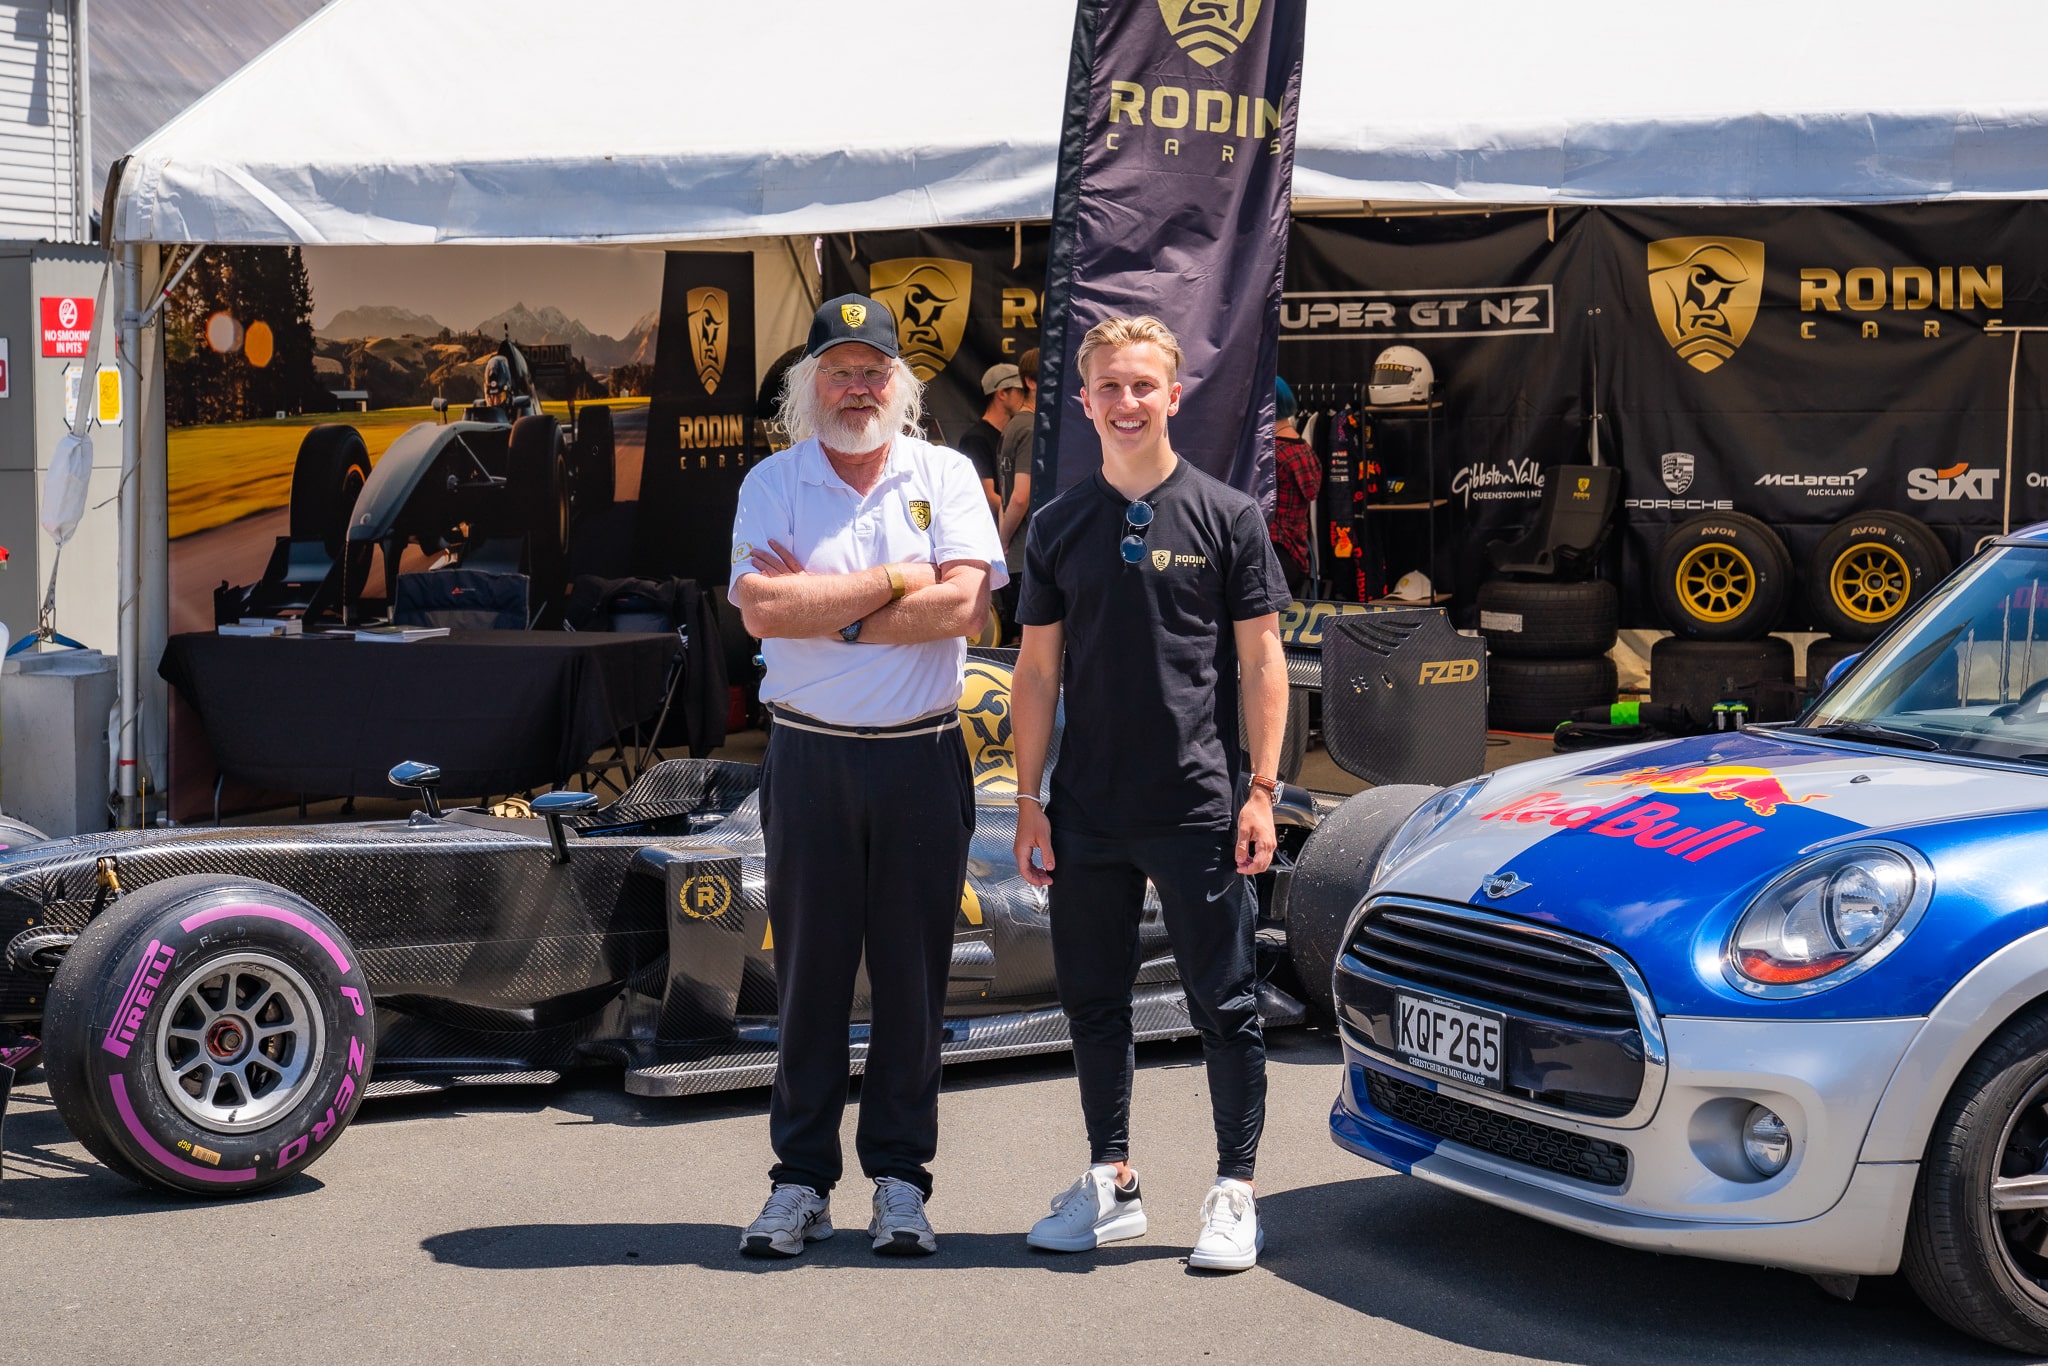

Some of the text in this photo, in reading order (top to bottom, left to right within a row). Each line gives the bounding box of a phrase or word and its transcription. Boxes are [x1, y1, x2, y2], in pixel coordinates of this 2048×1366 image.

[1108, 80, 1284, 139] RODIN
[1106, 133, 1281, 163] CARS
[1800, 265, 2003, 311] RODIN
[1280, 296, 1540, 328] UPER GT NZ
[44, 330, 56, 341] NO
[56, 342, 82, 353] IN PITS
[679, 414, 744, 449] RODIN
[680, 453, 744, 470] CARS
[1452, 457, 1545, 510] Gibbston Valle
[1754, 470, 1861, 486] McLaren
[1806, 488, 1855, 496] AUCKLAND
[1472, 489, 1543, 500] QUEENSTOWN NZ
[1624, 499, 1734, 509] PORSCHE
[1701, 527, 1737, 538] AVON
[1850, 526, 1886, 537] AVON
[1175, 554, 1206, 564] RODIN
[1418, 658, 1479, 686] FZED
[1480, 792, 1766, 863] Red Bull
[102, 939, 176, 1059] PIRELLI
[1401, 1002, 1499, 1072] KQF265
[277, 986, 366, 1170] P ZERO
[1408, 1056, 1486, 1086] CHRISTCHURCH MINI GARAGE
[177, 1139, 192, 1152] BGP
